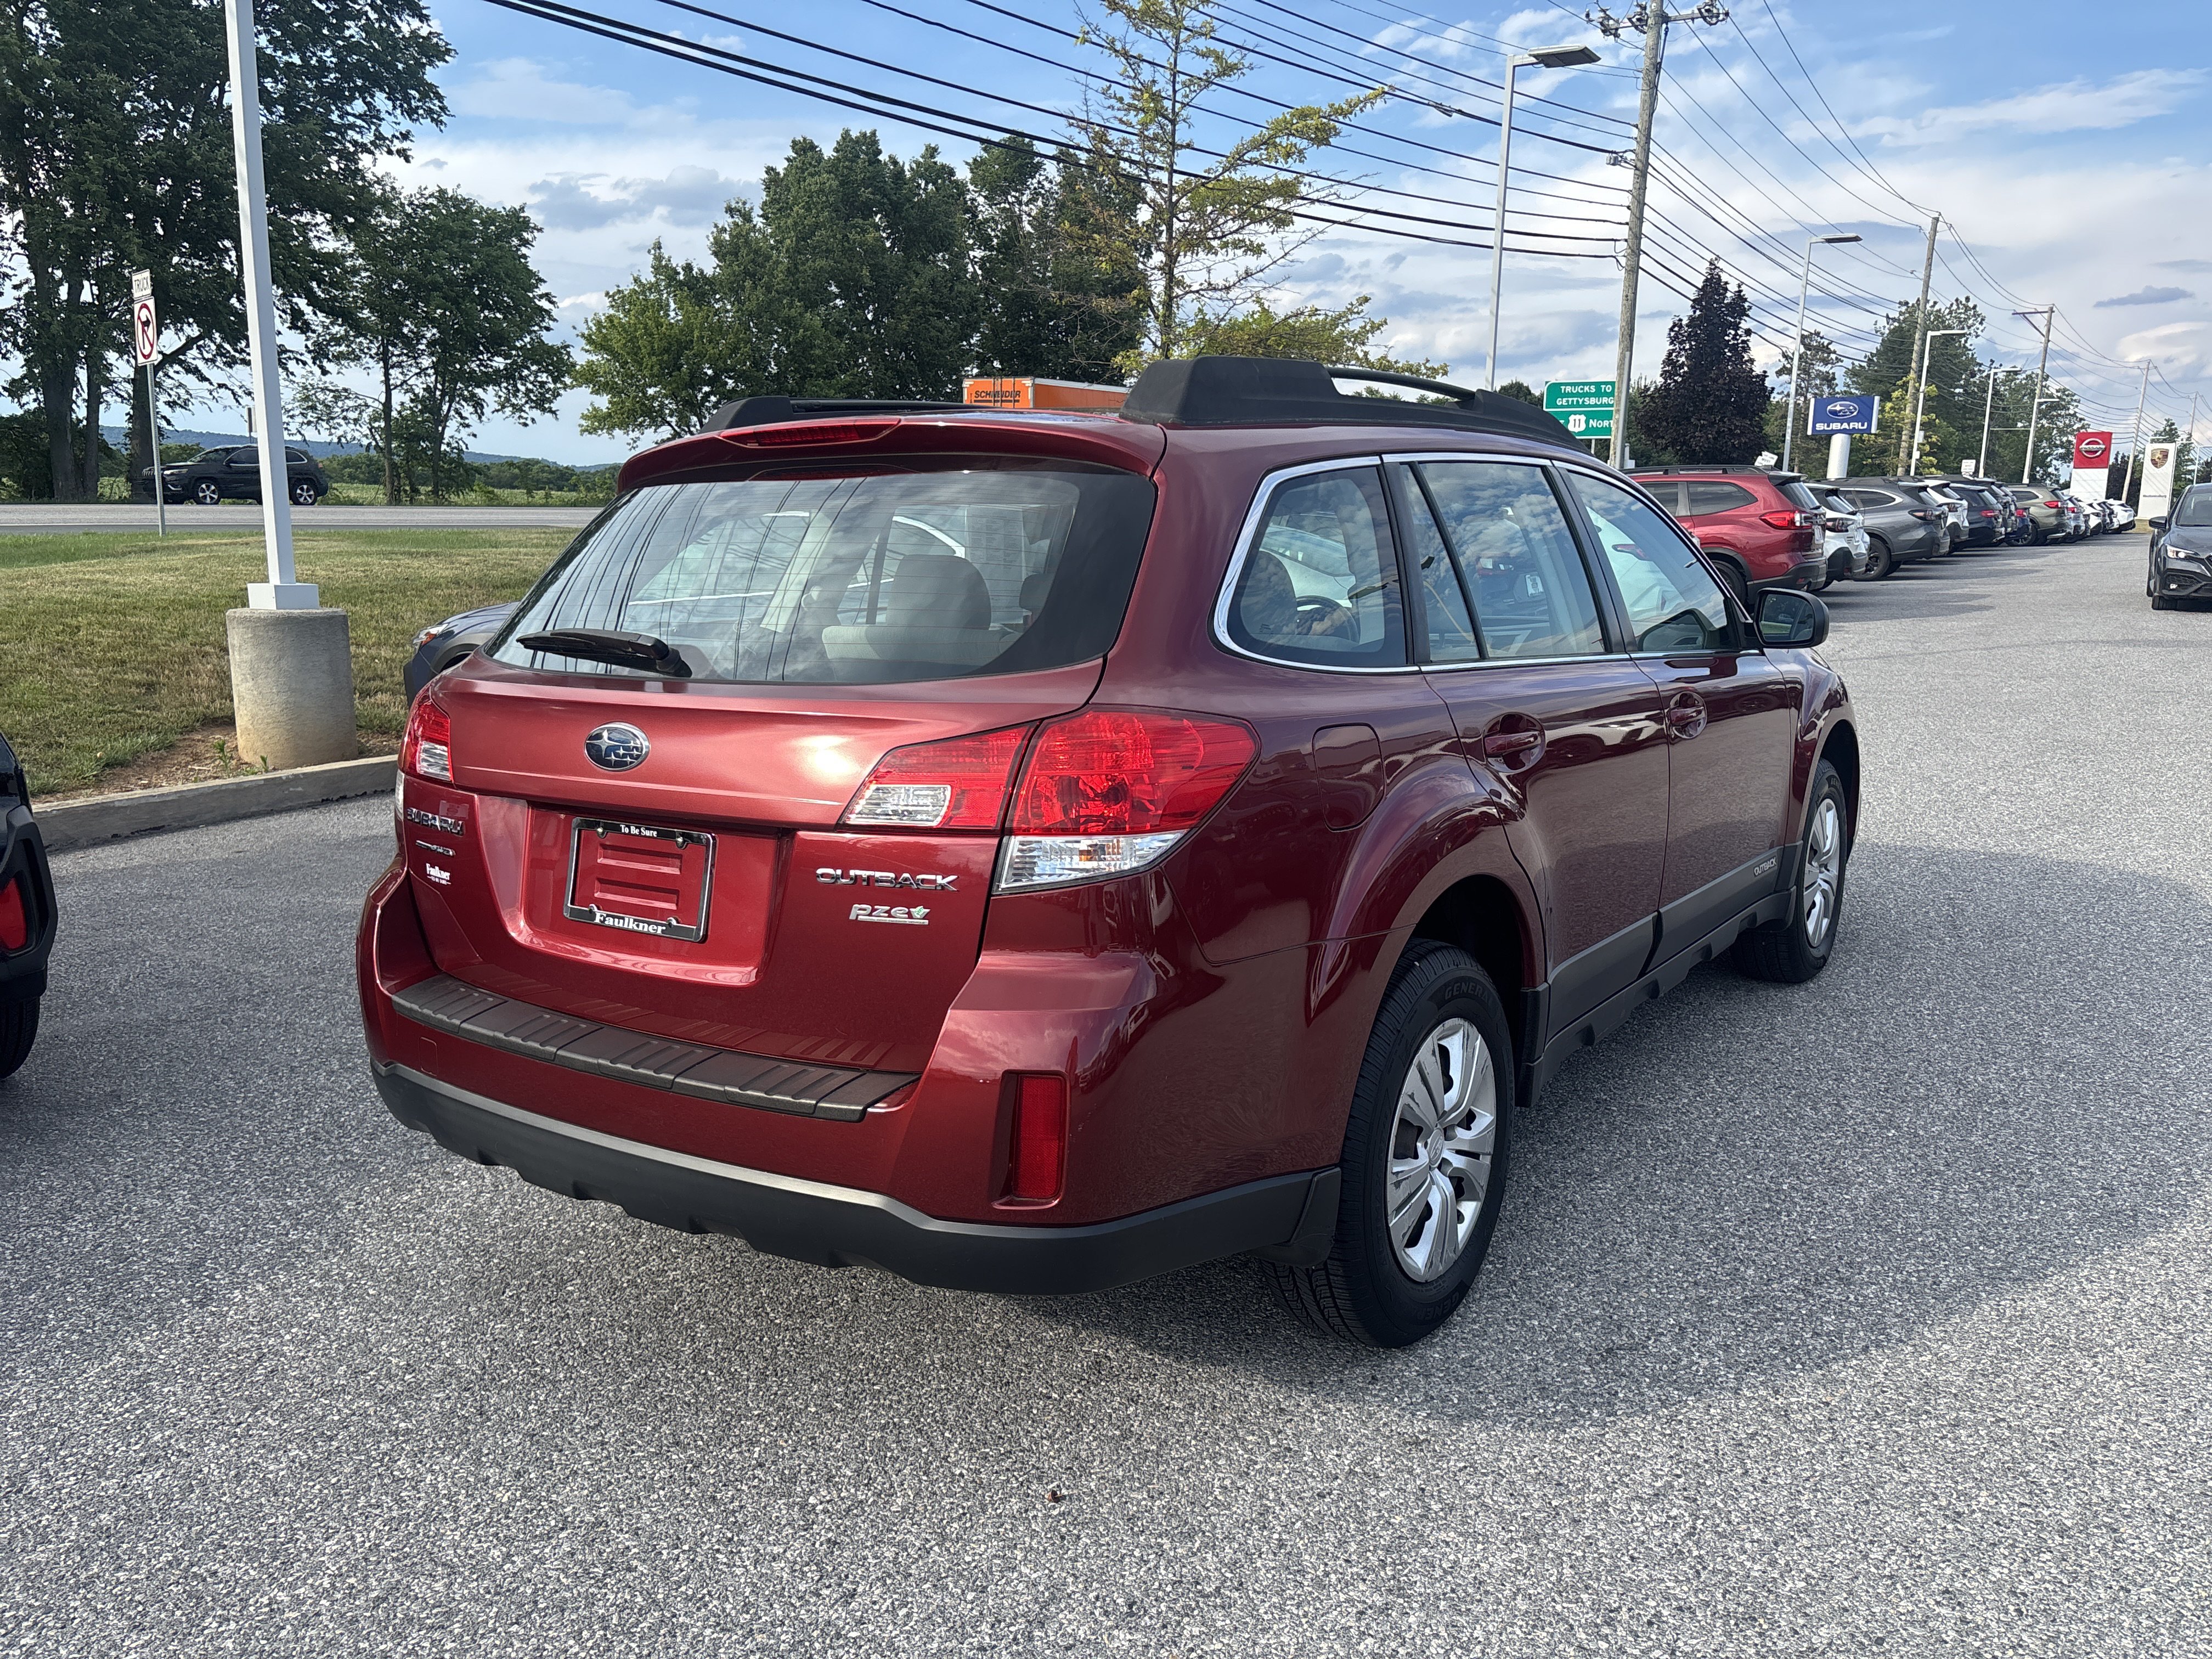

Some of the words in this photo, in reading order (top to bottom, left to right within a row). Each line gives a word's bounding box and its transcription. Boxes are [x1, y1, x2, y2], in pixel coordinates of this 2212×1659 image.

[134, 276, 149, 293] TRUCK
[1560, 385, 1595, 393] TRUCKS
[1556, 397, 1614, 405] GETTYSBURG
[1573, 419, 1581, 428] 11
[1589, 419, 1613, 427] NORT
[1815, 422, 1867, 431] SUBARU
[407, 808, 464, 837] SUBARU
[620, 825, 629, 833] To
[631, 826, 640, 835] Be
[641, 827, 657, 837] Sure
[426, 863, 450, 881] Faulkner
[1754, 857, 1777, 876] OUTBACK
[816, 868, 958, 891] OUTBACK
[594, 912, 666, 934] Faulkner
